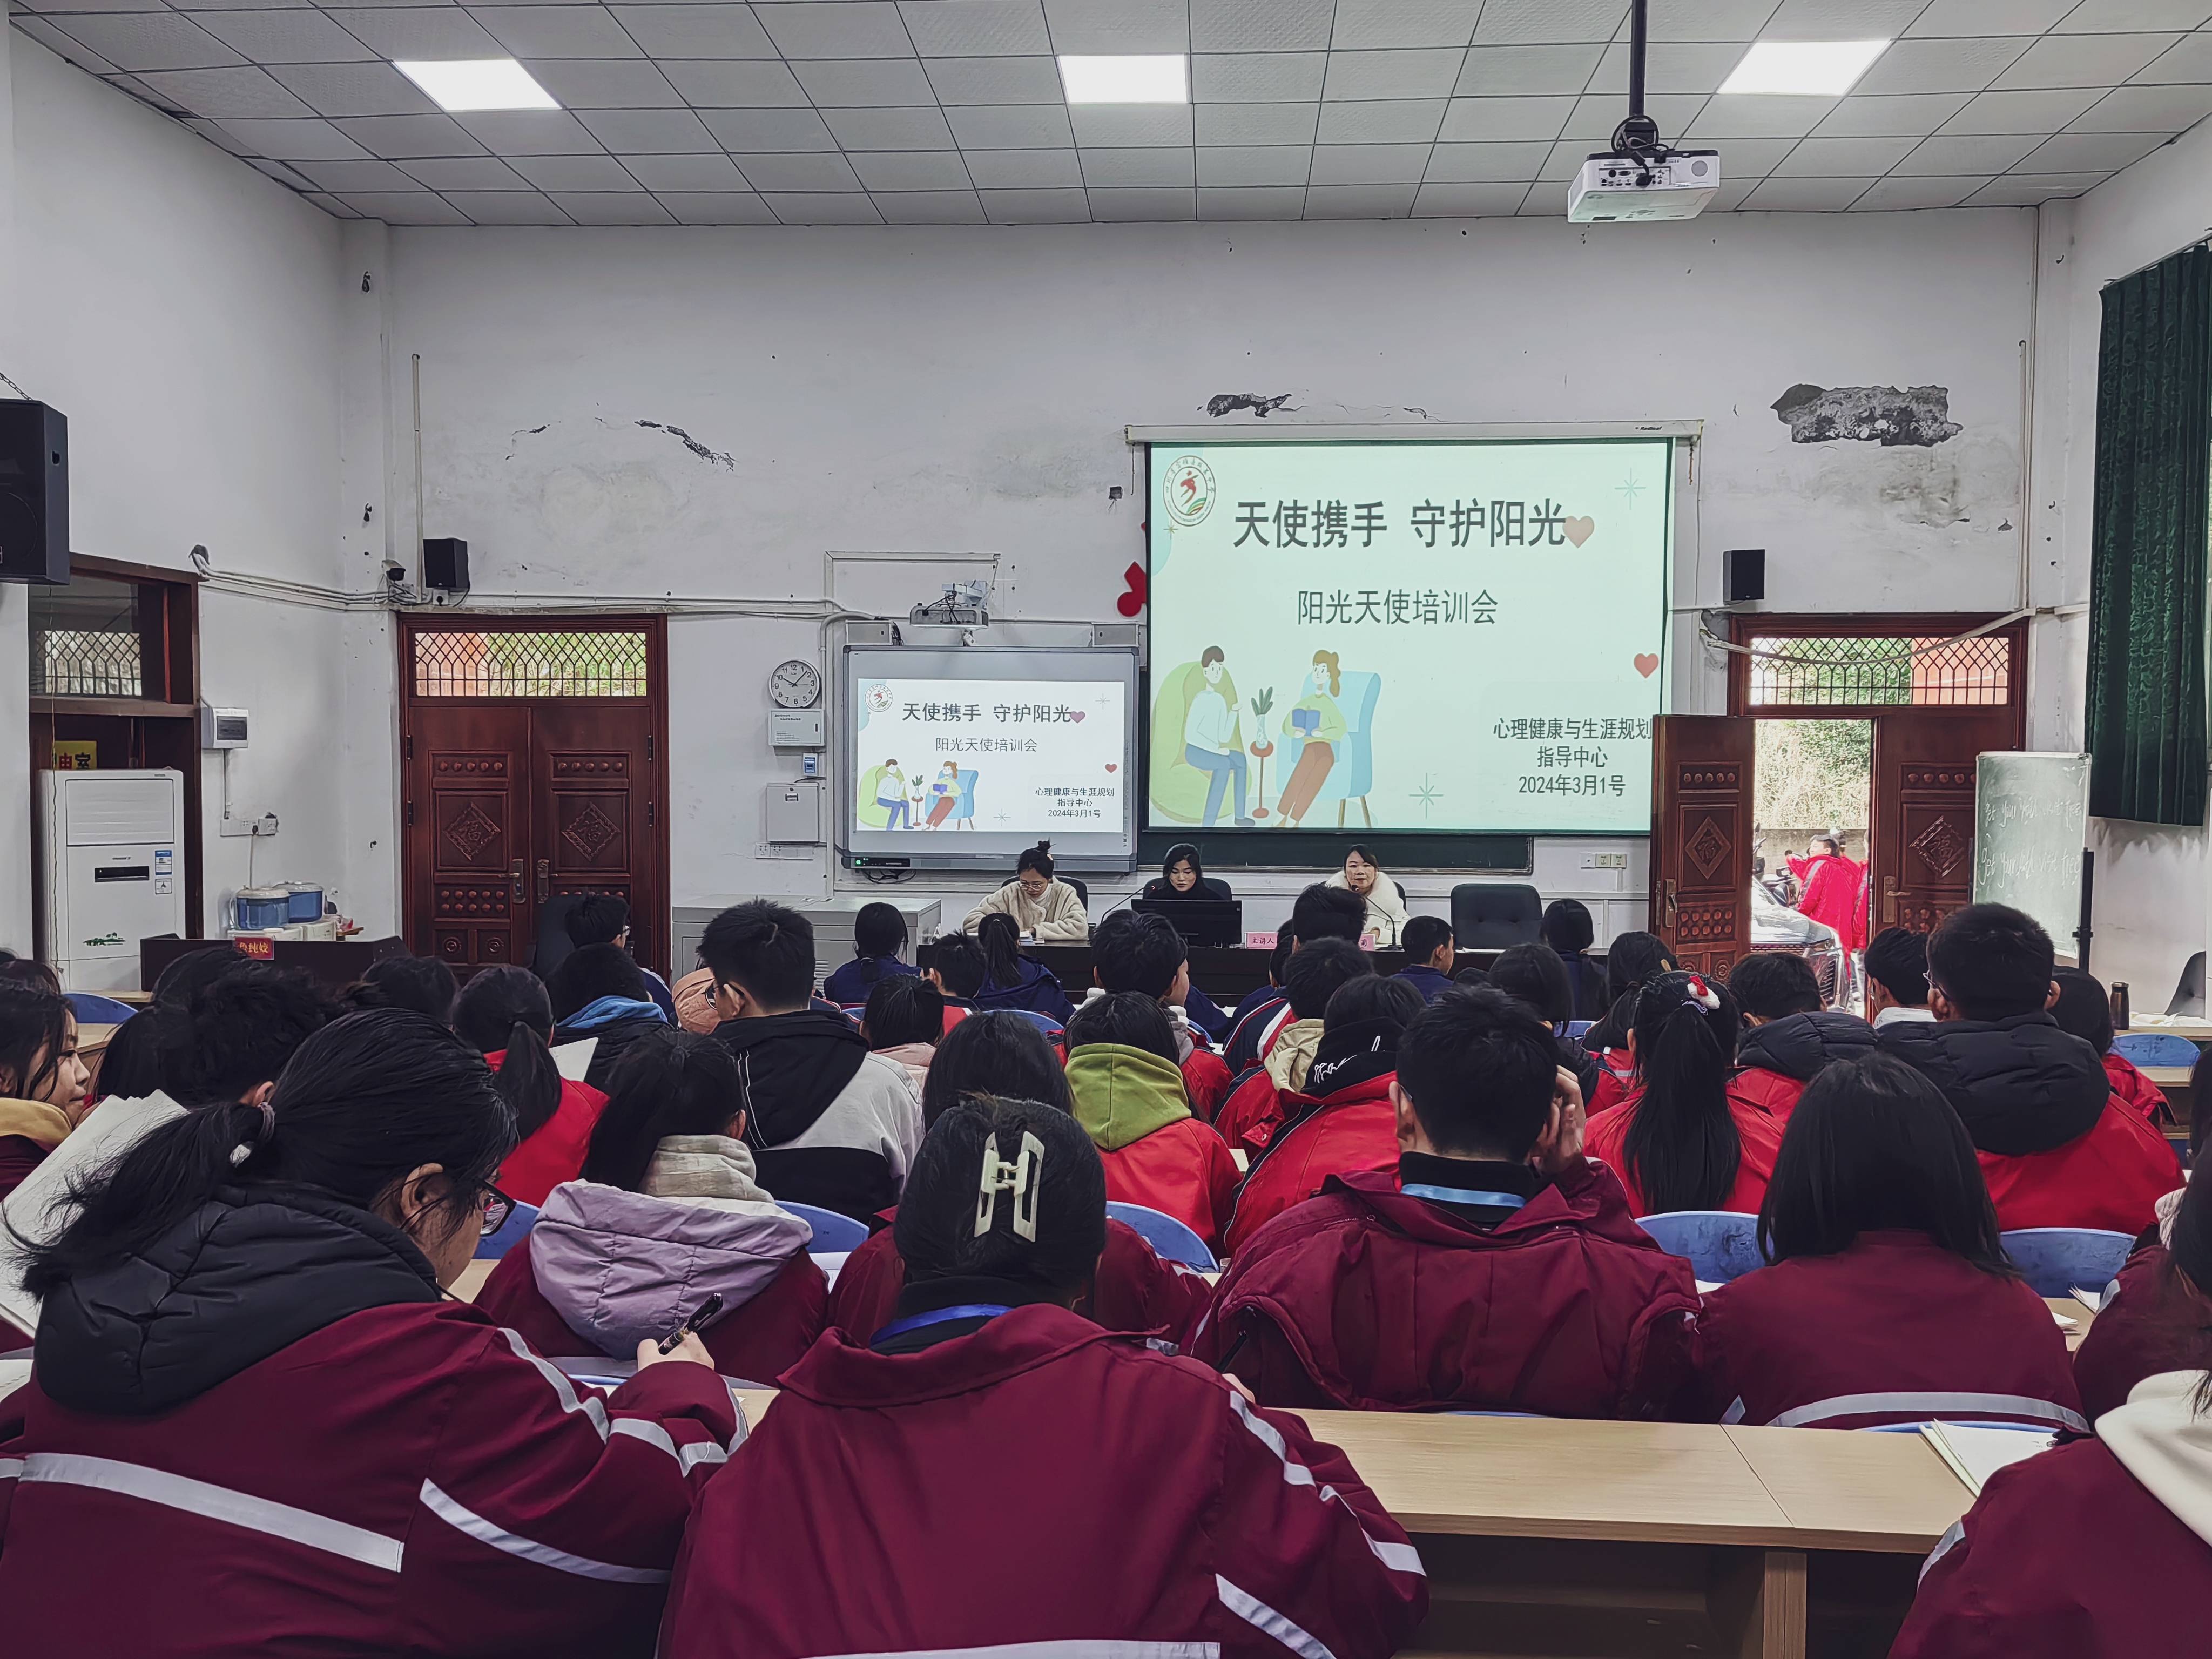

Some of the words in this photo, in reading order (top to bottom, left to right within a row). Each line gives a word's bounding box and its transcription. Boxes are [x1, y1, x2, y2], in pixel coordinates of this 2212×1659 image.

[1233, 499, 1387, 548] 天使携手
[1411, 498, 1566, 548] 守护阳光
[1298, 589, 1498, 625] 阳光天使培训会
[902, 703, 982, 722] 天使携手
[993, 704, 1071, 723] 守护阳光
[1493, 717, 1653, 740] 心理健康与生涯规划
[935, 737, 1038, 752] 阳光天使培训会
[1537, 745, 1609, 768] 指导中心
[1035, 787, 1115, 797] 心理健康与生涯规划
[1519, 774, 1626, 797] 2024年3月1号
[1057, 798, 1093, 807] 指导中心
[1048, 808, 1102, 818] 2024年3月1号
[1251, 937, 1275, 945] 主讲人
